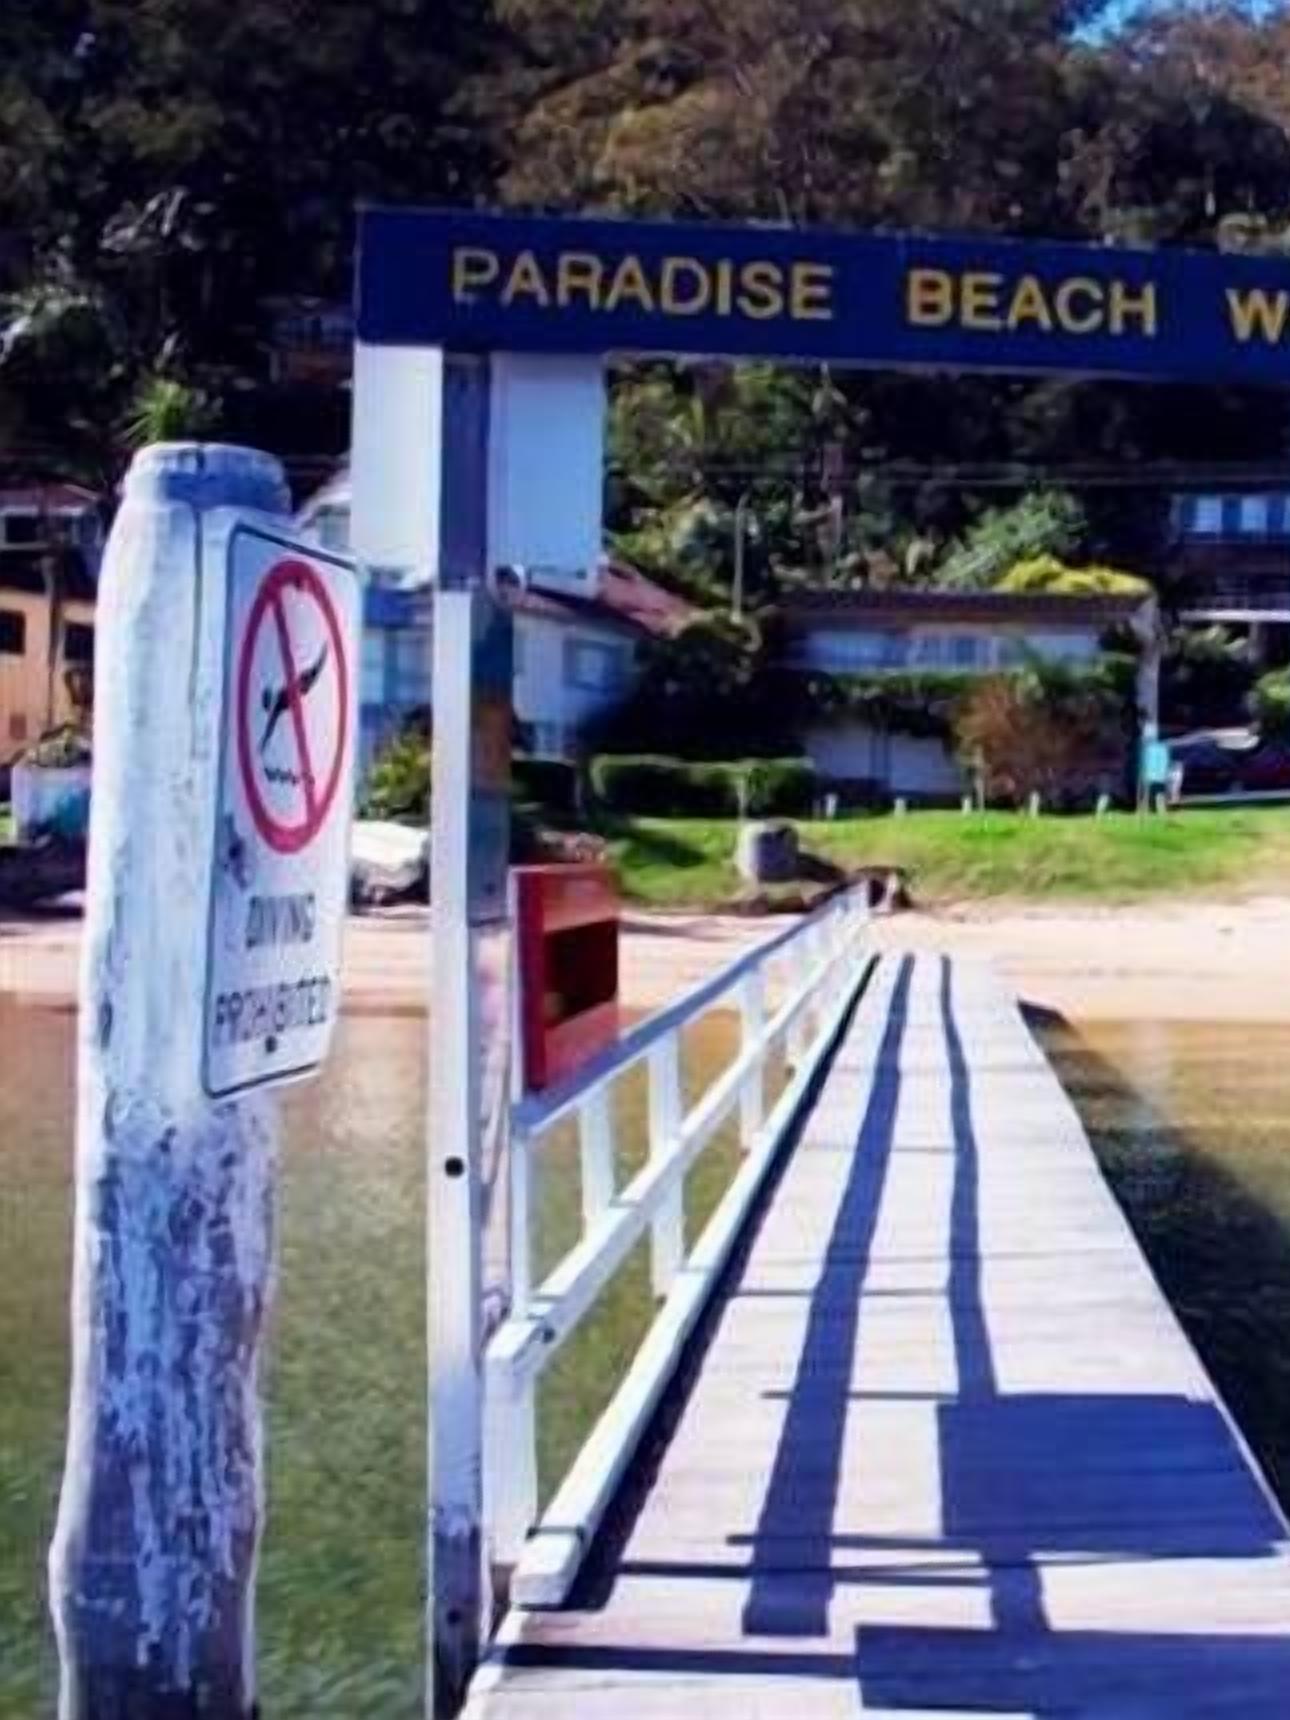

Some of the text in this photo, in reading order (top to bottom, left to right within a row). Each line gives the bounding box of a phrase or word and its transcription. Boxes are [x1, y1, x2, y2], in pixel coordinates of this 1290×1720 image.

[452, 246, 835, 321] PARADISE
[906, 268, 1158, 336] BEACH
[244, 893, 315, 948] DIVING
